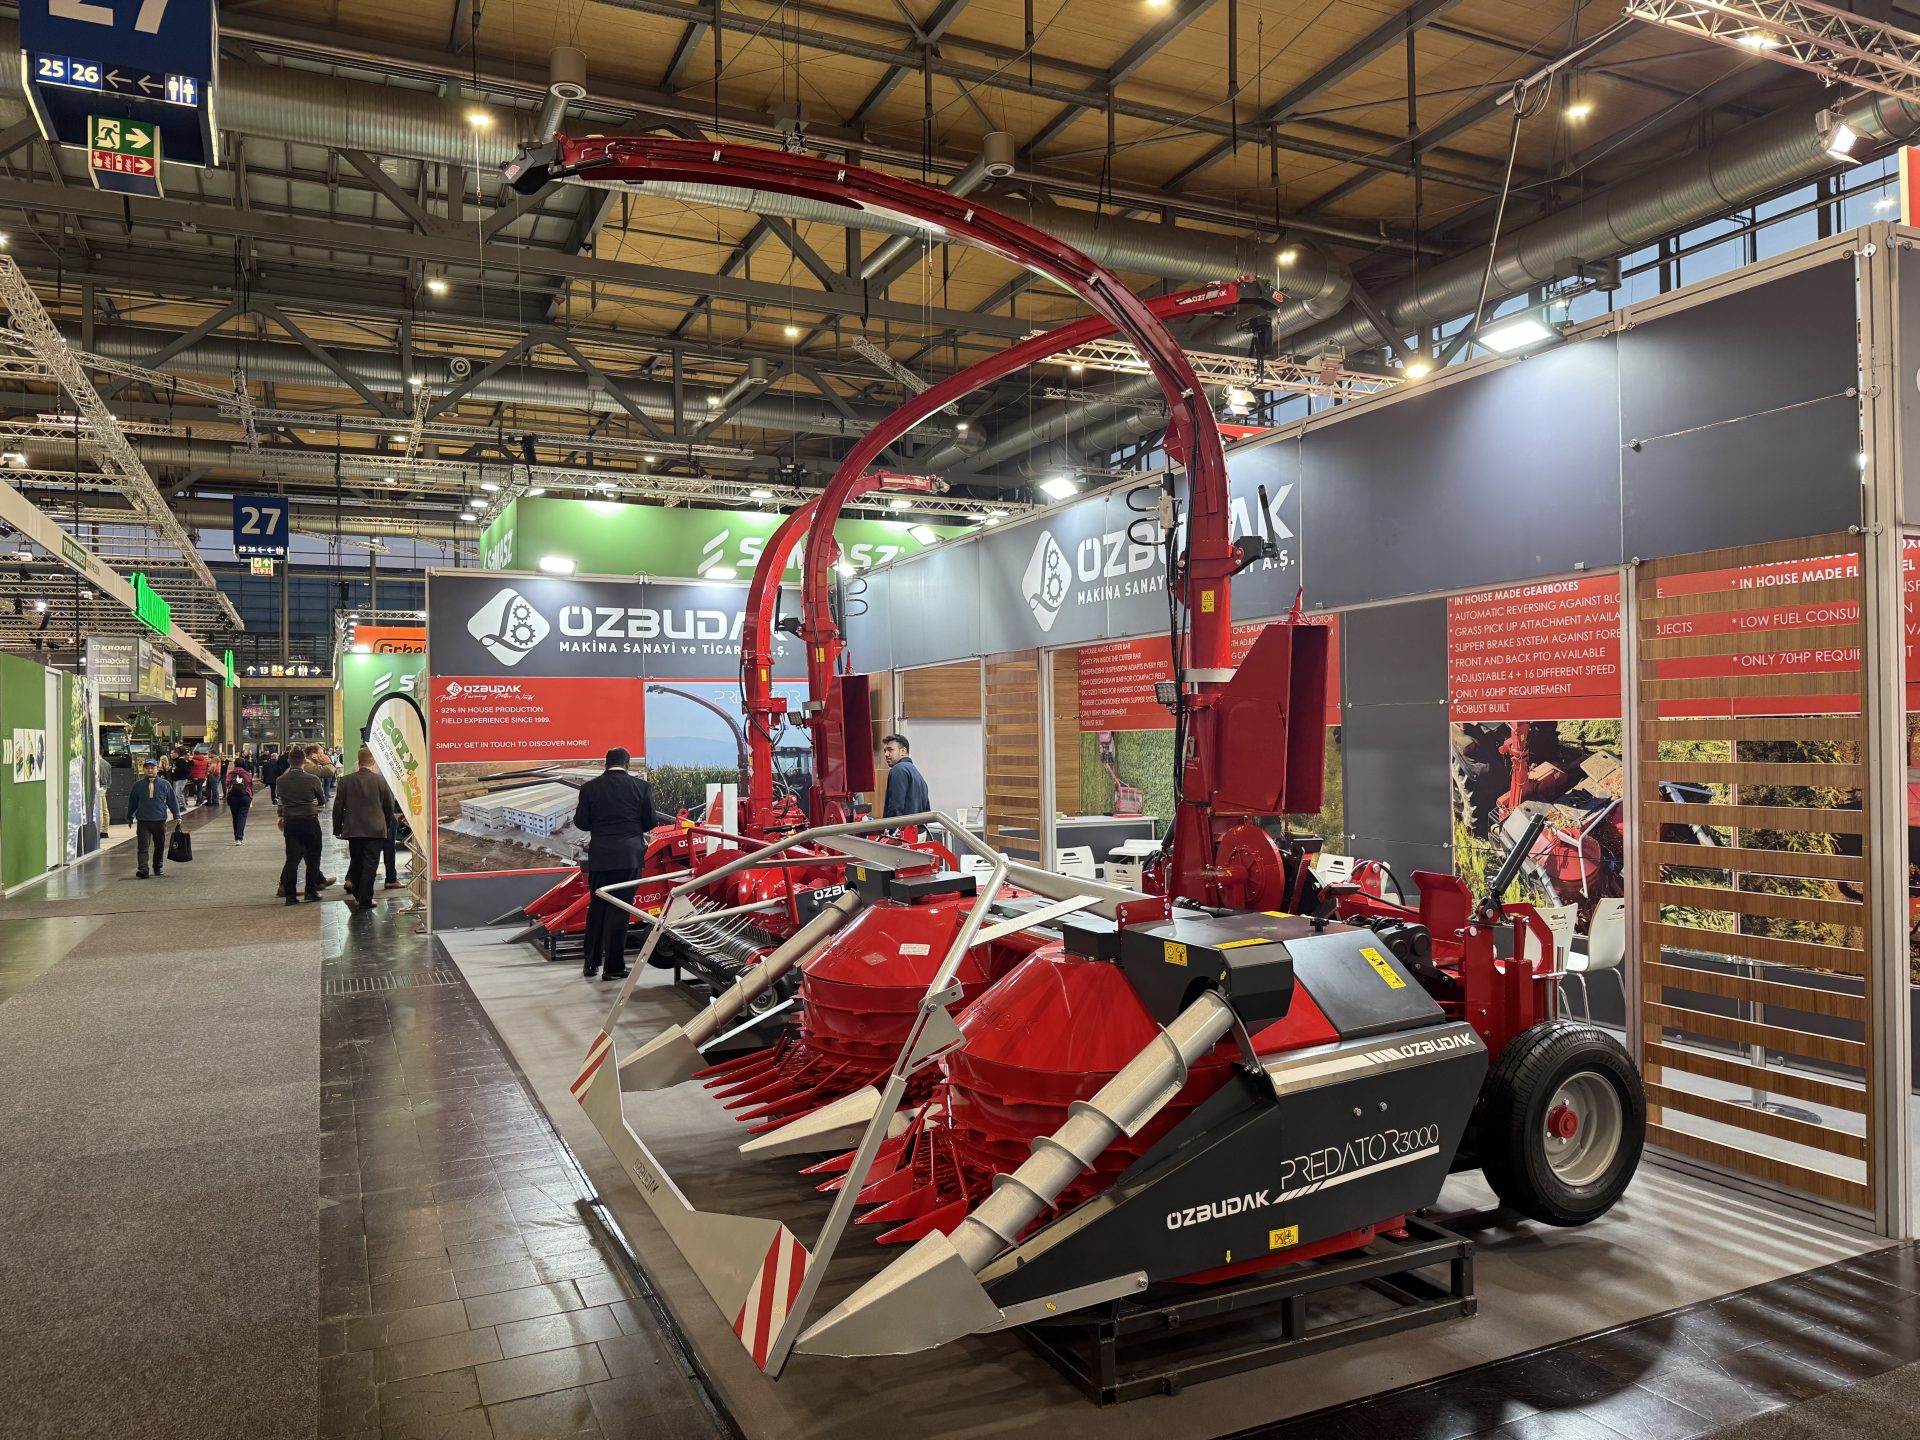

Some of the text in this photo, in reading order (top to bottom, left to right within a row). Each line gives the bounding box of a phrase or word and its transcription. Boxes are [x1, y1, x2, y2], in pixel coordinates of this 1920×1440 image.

[38, 58, 99, 83] 25 26
[241, 506, 280, 535] 27
[1124, 574, 1164, 597] SANAY
[1740, 566, 1859, 589] IN HOUSE MADE FL
[1454, 581, 1579, 606] IN HOUSE MADE GEARBOXES
[1455, 607, 1504, 621] AUTOMATIC
[1506, 600, 1556, 615] REVERSING
[1558, 595, 1601, 609] AGAINST
[1455, 612, 1620, 636] GRASS PICK UP ATTACHMENT AVAILA
[1656, 608, 1859, 635] BJECTS LOW FUEL CONSU
[559, 640, 617, 654] MAKİNA
[622, 640, 676, 654] SANAYİ
[680, 646, 697, 655] ve
[702, 642, 742, 656] TİCAR
[1487, 639, 1514, 650] BRAKE
[1516, 636, 1549, 647] SYSTEM
[1551, 631, 1594, 644] AGAINST
[1596, 629, 1620, 640] FORE
[1455, 647, 1606, 667] FRONT AND BACK PTO AVAILABLE
[1742, 654, 1775, 667] ONLY
[1779, 652, 1811, 664] 70HP
[260, 666, 269, 674] 13
[1455, 671, 1506, 683] ADJUSTABLE
[1508, 672, 1513, 680] 4
[1524, 669, 1534, 678] 16
[1536, 666, 1583, 678] DIFFERENT
[1585, 664, 1616, 675] SPEED
[1456, 684, 1572, 698] ONLY 160HP REQUIREMENT
[1456, 703, 1510, 713] ROBUST BUILT
